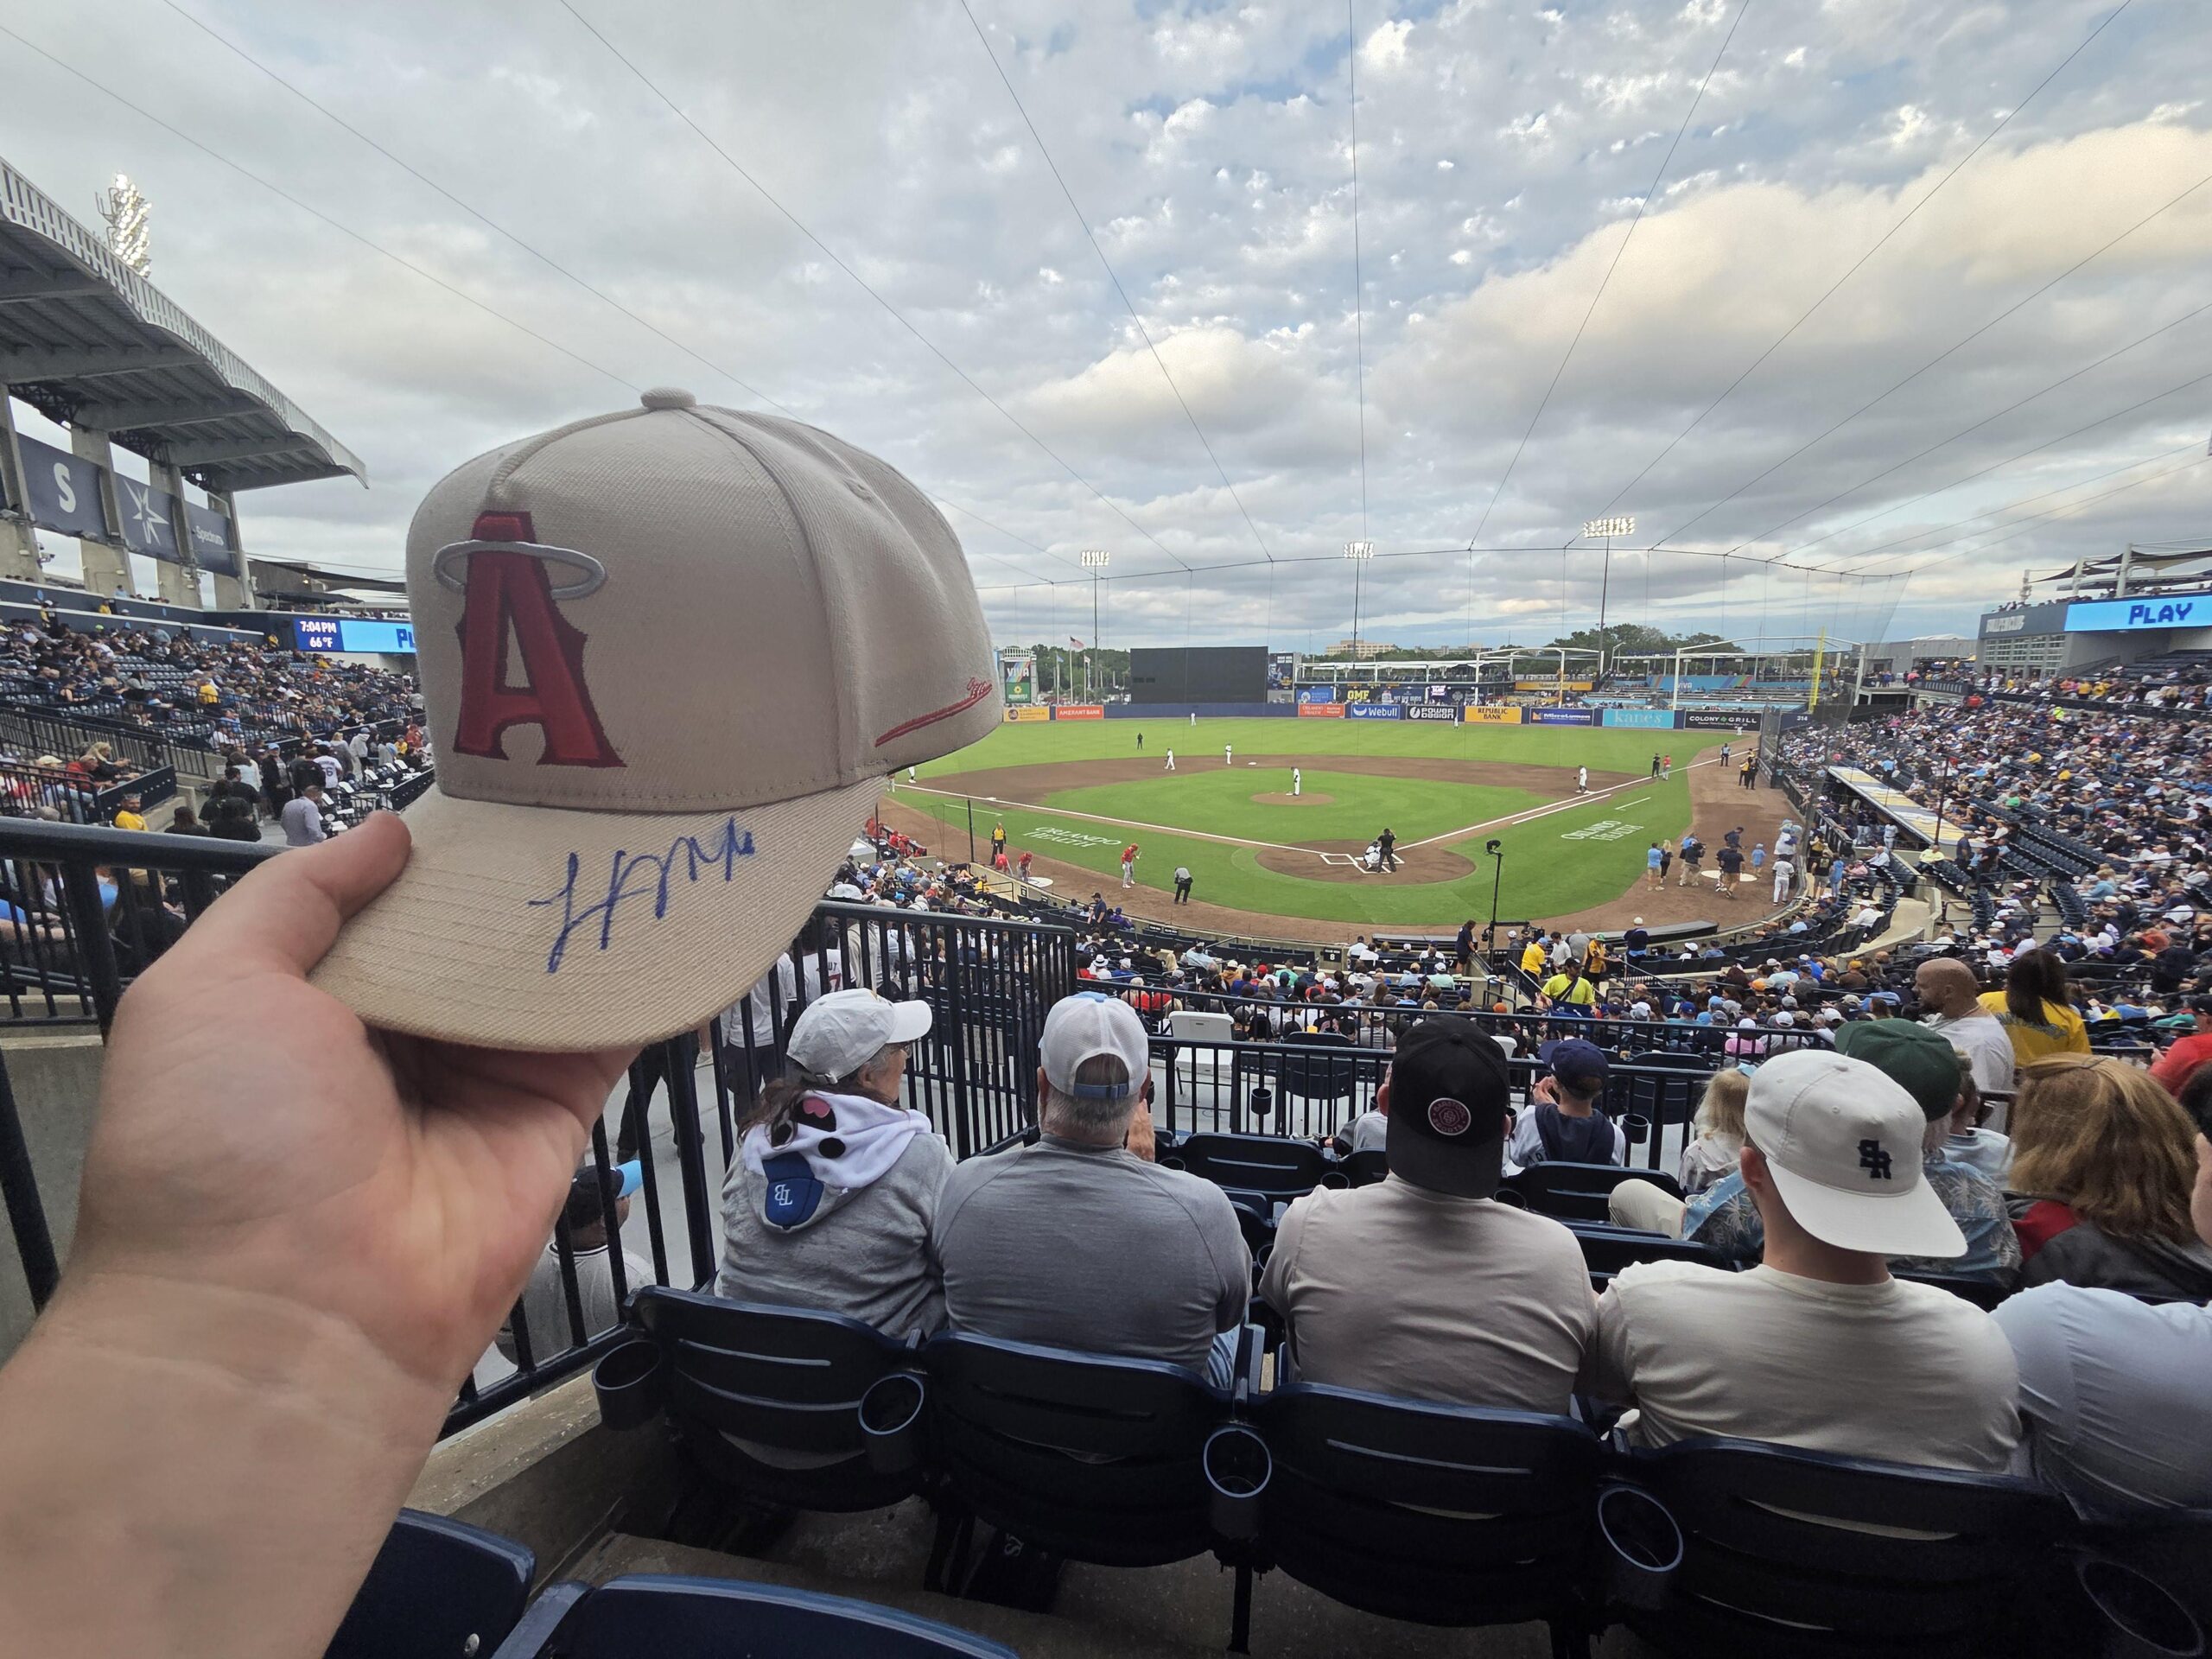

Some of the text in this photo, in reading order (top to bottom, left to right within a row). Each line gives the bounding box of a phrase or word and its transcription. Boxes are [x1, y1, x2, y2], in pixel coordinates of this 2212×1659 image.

[53, 463, 76, 513] S
[2128, 603, 2193, 625] PLAY
[300, 620, 337, 633] 7:04 PM
[454, 511, 628, 767] A
[1007, 667, 1029, 677] VIVA
[1368, 708, 1397, 716] Webull
[1614, 710, 1662, 724] kane's
[1023, 831, 1096, 848] HEALTH
[1035, 827, 1122, 845] ORLANDO
